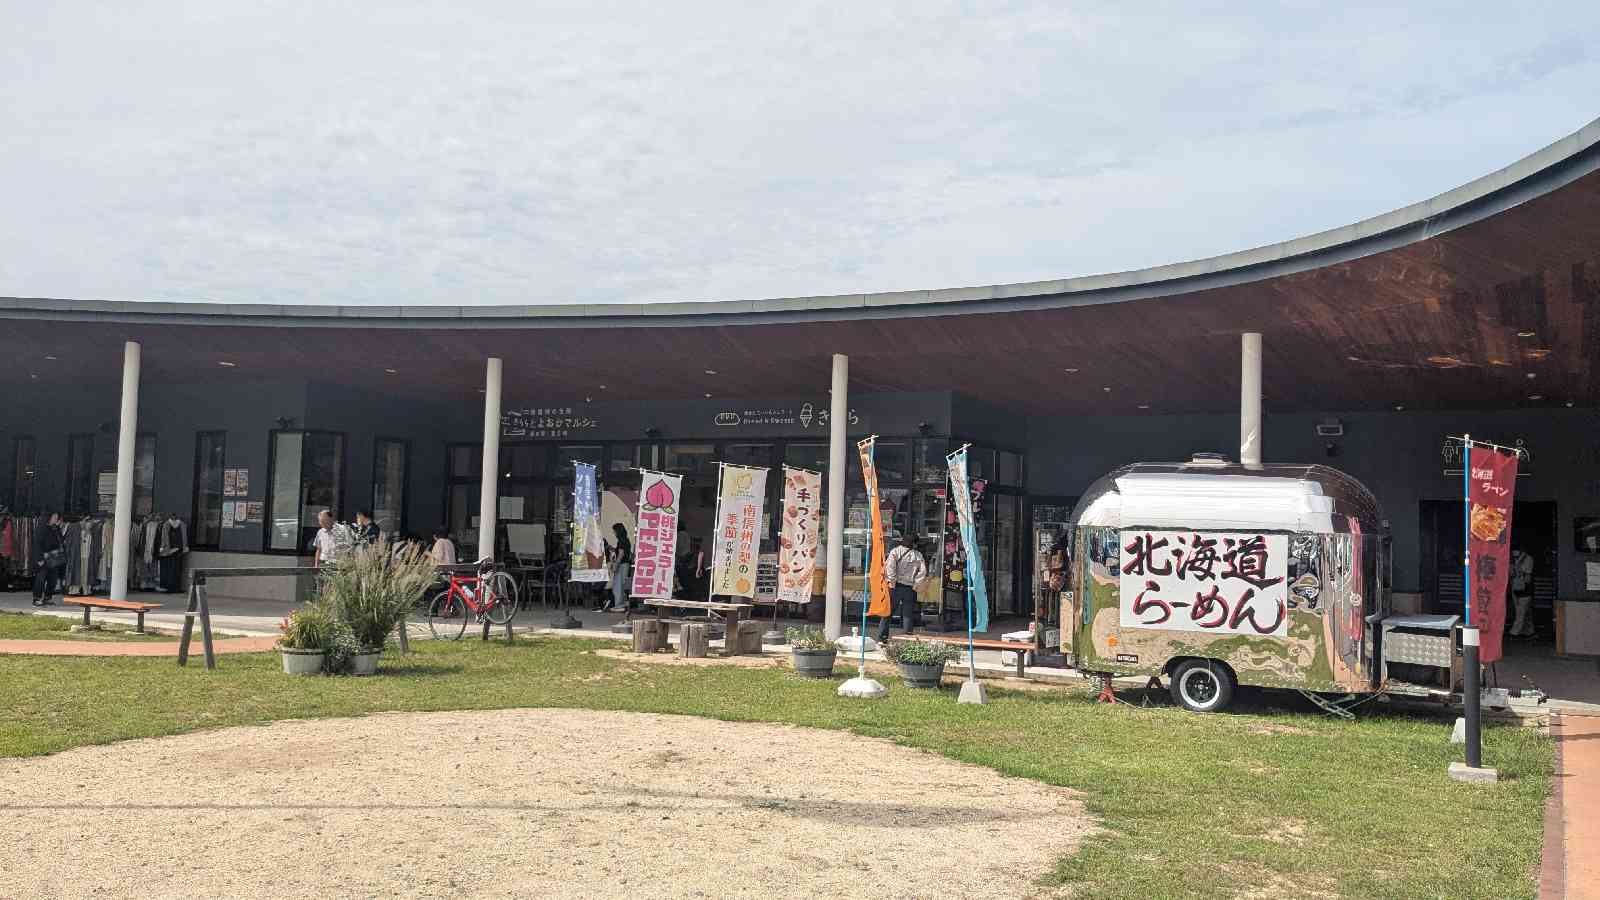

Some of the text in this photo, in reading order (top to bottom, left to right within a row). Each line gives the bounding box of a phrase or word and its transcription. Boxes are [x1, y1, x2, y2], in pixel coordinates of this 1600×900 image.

[635, 512, 660, 595] PEACH
[792, 488, 811, 574] 手づくりパン
[1122, 532, 1285, 591] 北海道
[1132, 580, 1286, 635] らーめん
